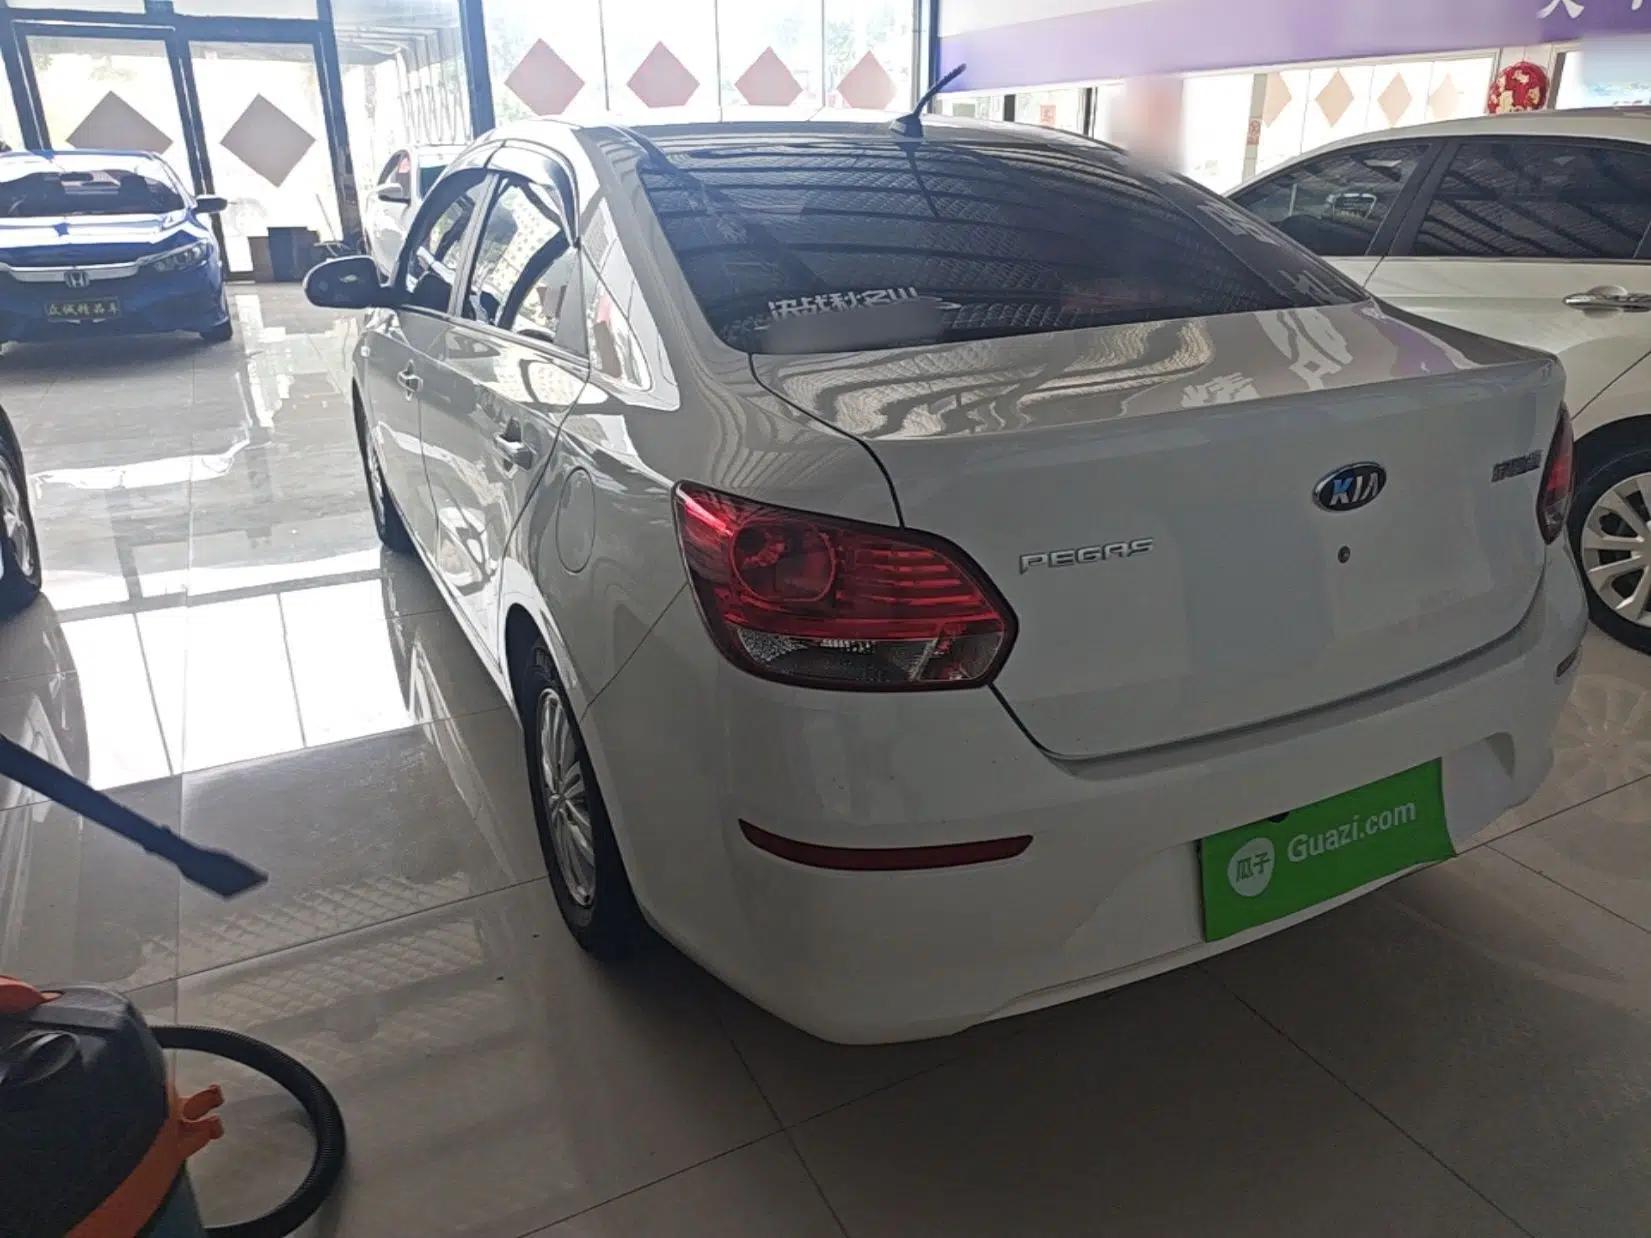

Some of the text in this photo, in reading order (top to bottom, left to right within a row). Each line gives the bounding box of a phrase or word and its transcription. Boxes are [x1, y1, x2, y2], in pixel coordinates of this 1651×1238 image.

[1328, 472, 1379, 506] KIA
[1019, 538, 1154, 575] PEGAS
[1287, 802, 1416, 863] Guazi.com
[1235, 851, 1271, 883] 瓜子
